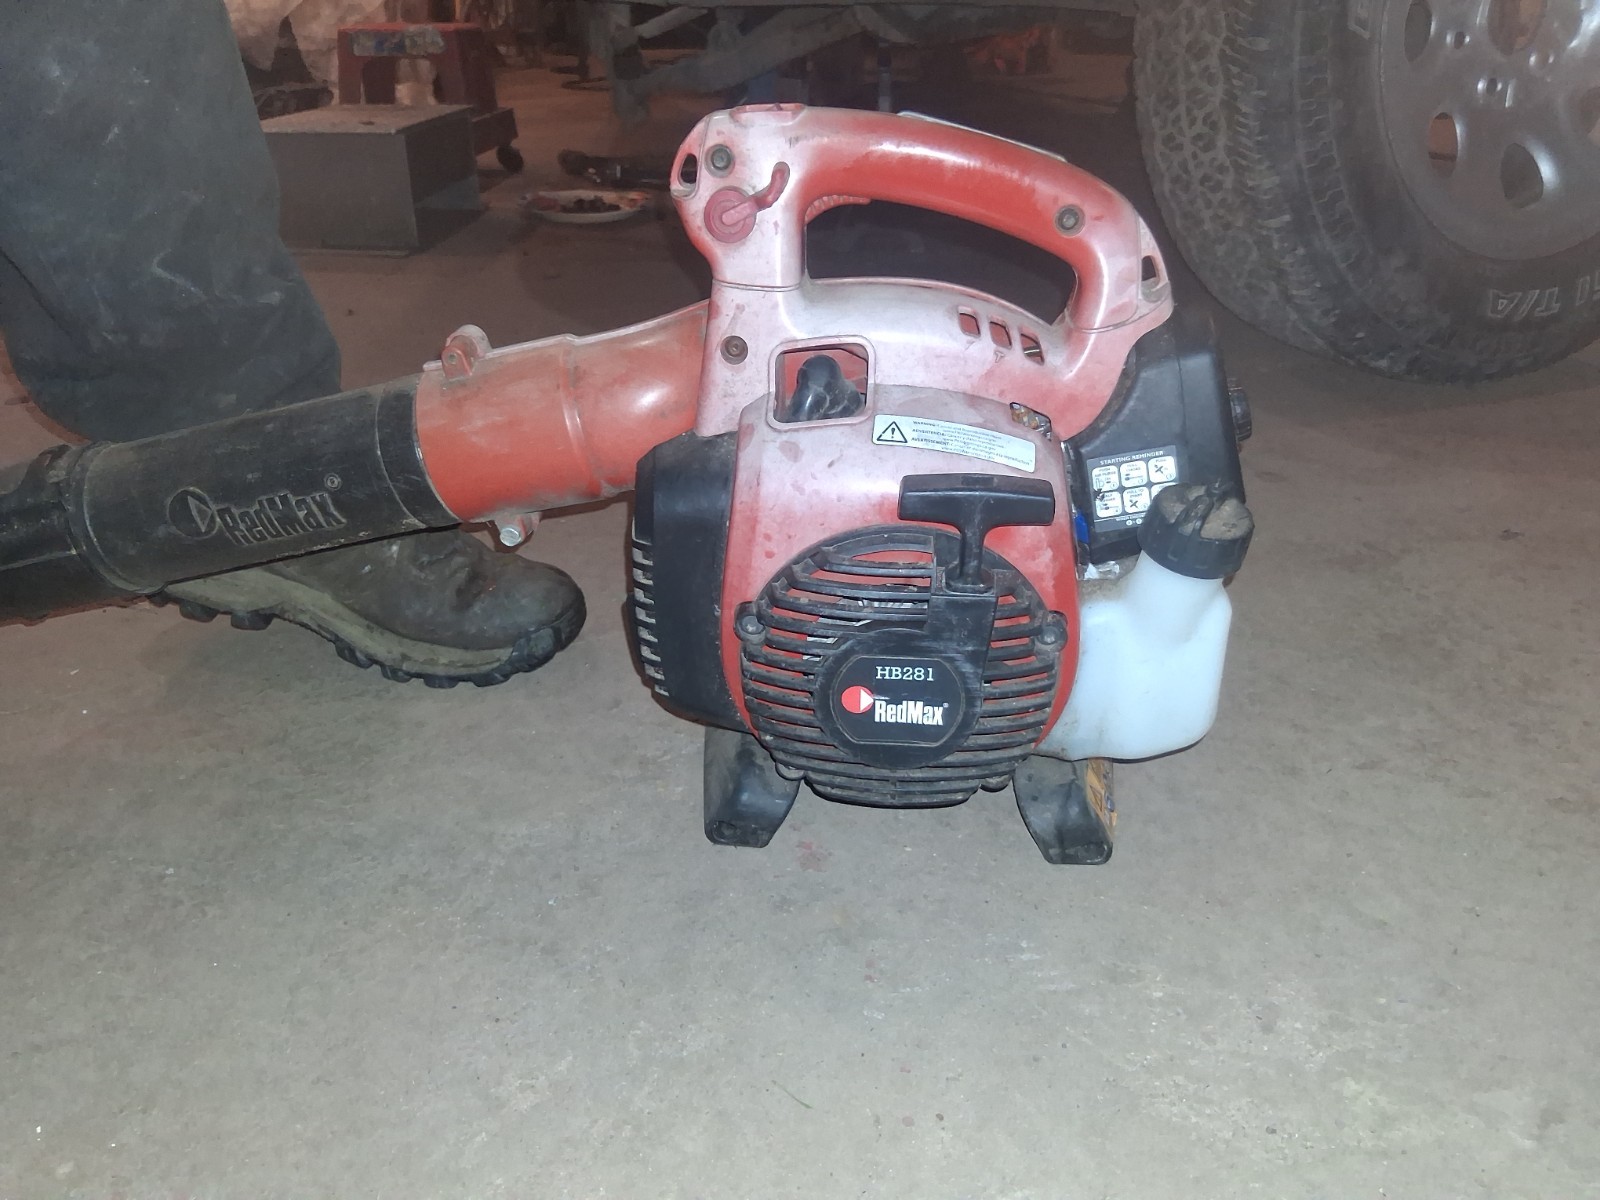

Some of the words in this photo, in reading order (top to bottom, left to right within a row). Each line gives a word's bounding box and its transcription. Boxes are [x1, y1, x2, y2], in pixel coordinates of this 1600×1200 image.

[1099, 455, 1131, 466] STARTING
[1131, 450, 1165, 460] REMINDER
[216, 492, 347, 546] RedMax
[875, 665, 935, 681] HB281
[874, 699, 945, 726] RedMax
